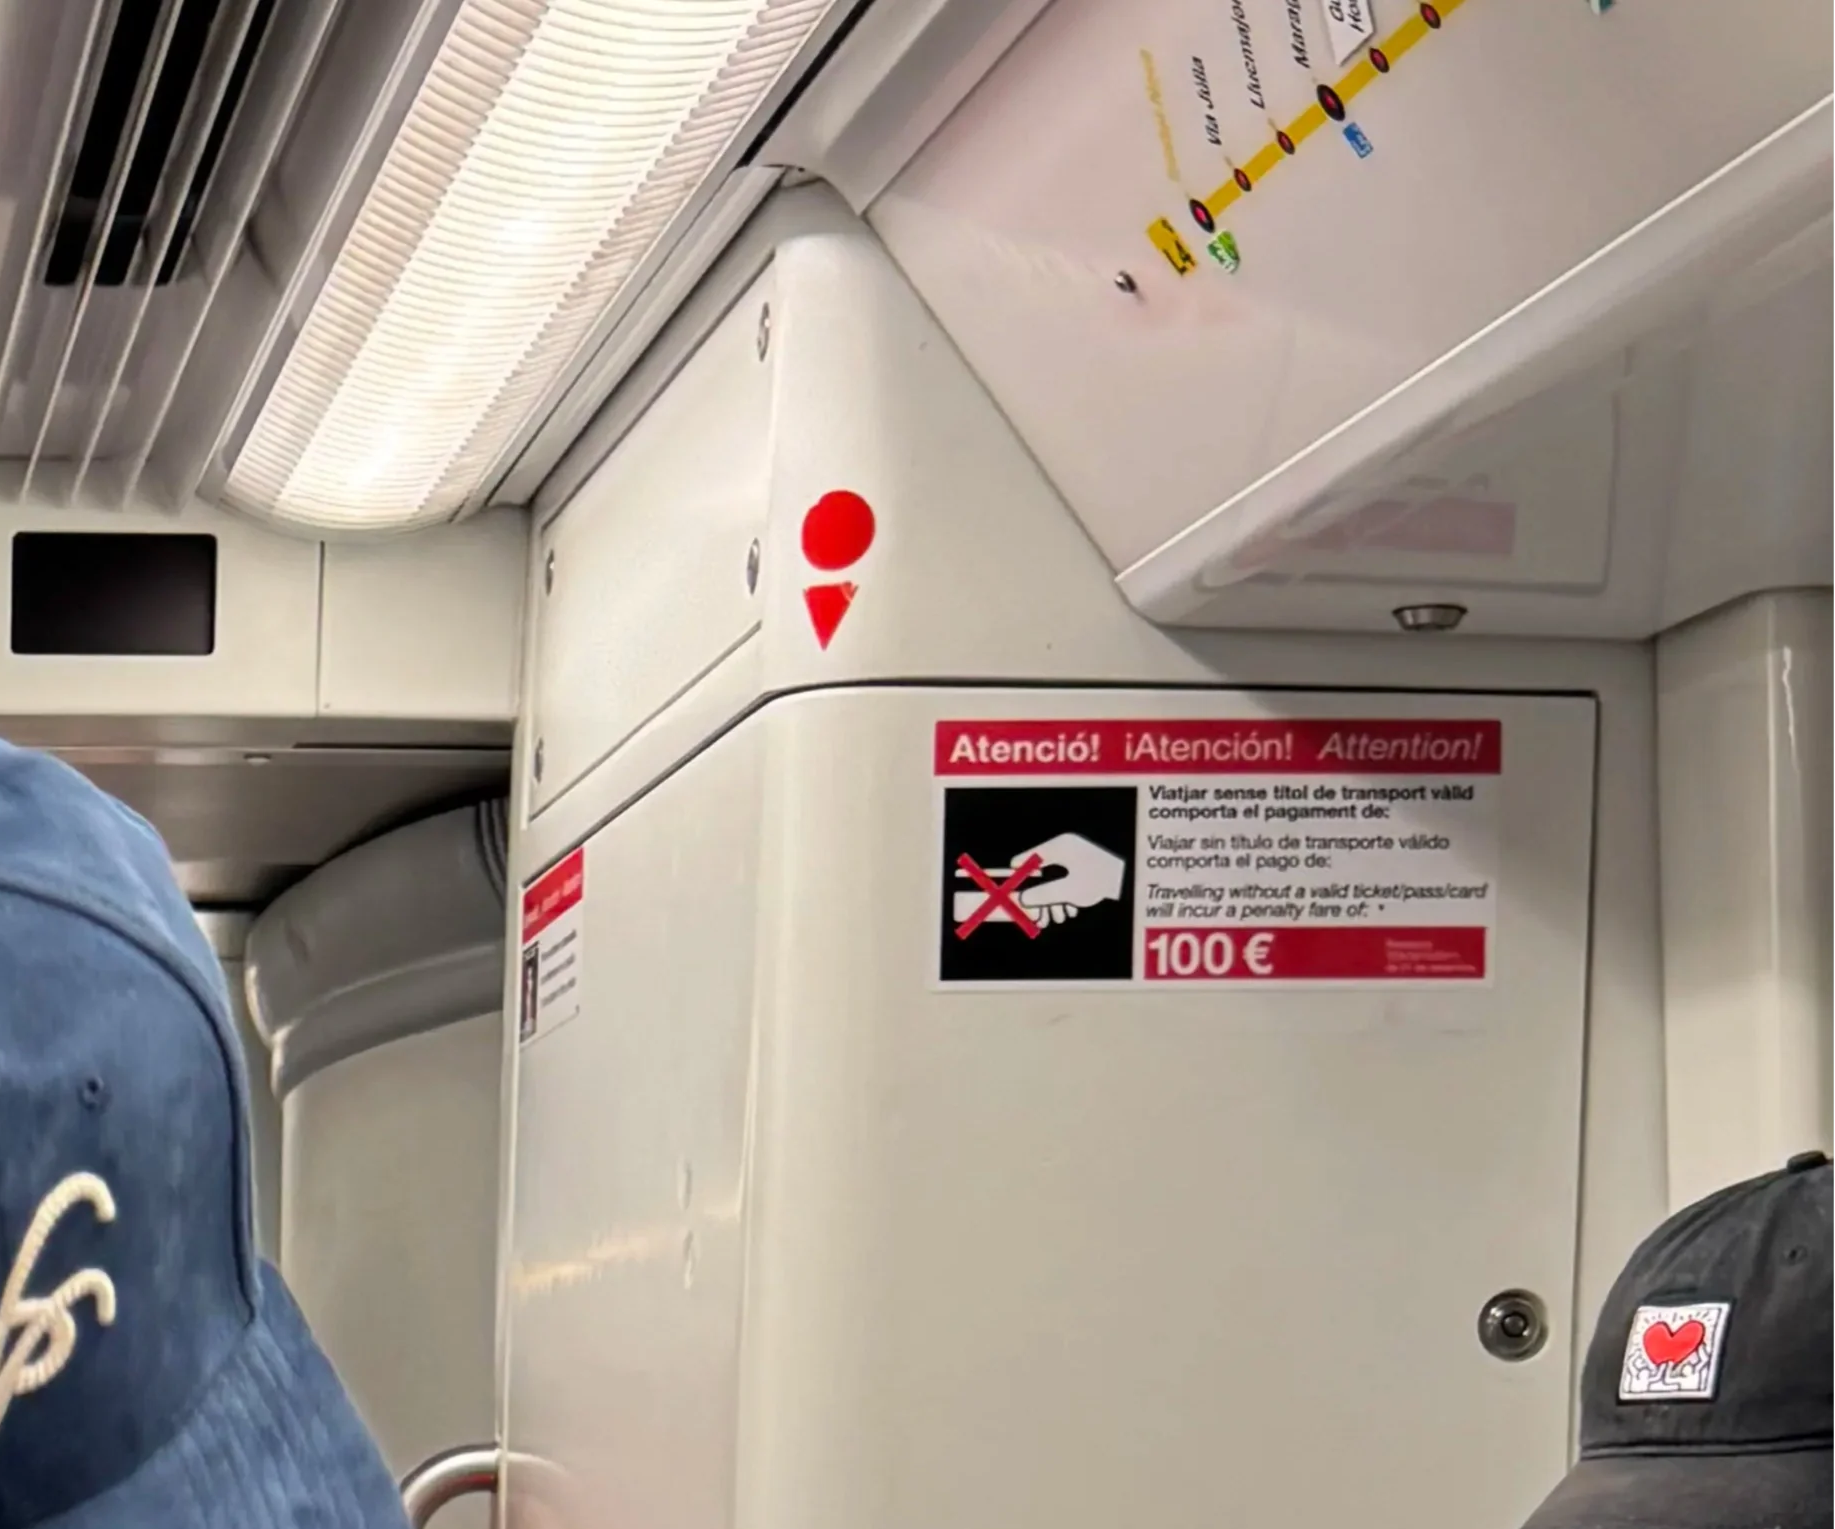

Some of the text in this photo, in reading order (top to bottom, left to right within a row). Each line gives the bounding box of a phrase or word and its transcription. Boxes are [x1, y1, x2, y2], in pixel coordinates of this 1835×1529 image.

[949, 731, 1483, 763] Atenció! ¡Atención! Attention!
[1149, 785, 1208, 803] Viatjar
[1214, 787, 1267, 801] sense
[1313, 784, 1336, 800] de
[1341, 785, 1426, 803] transport
[1148, 803, 1390, 822] comporta el pagament de:
[1147, 834, 1196, 852] Viajar
[1200, 834, 1226, 850] sin
[1278, 833, 1301, 850] de
[1305, 835, 1394, 852] transporte
[1146, 853, 1332, 872] comporta el pago de:
[1147, 881, 1489, 902] Travelling without a valid ticket/pass/card
[1146, 902, 1174, 918] will
[1178, 902, 1222, 918] incur
[1226, 904, 1236, 918] a
[1240, 902, 1304, 921] penalty
[1308, 901, 1342, 918] fare
[1148, 932, 1275, 975] 100 €
